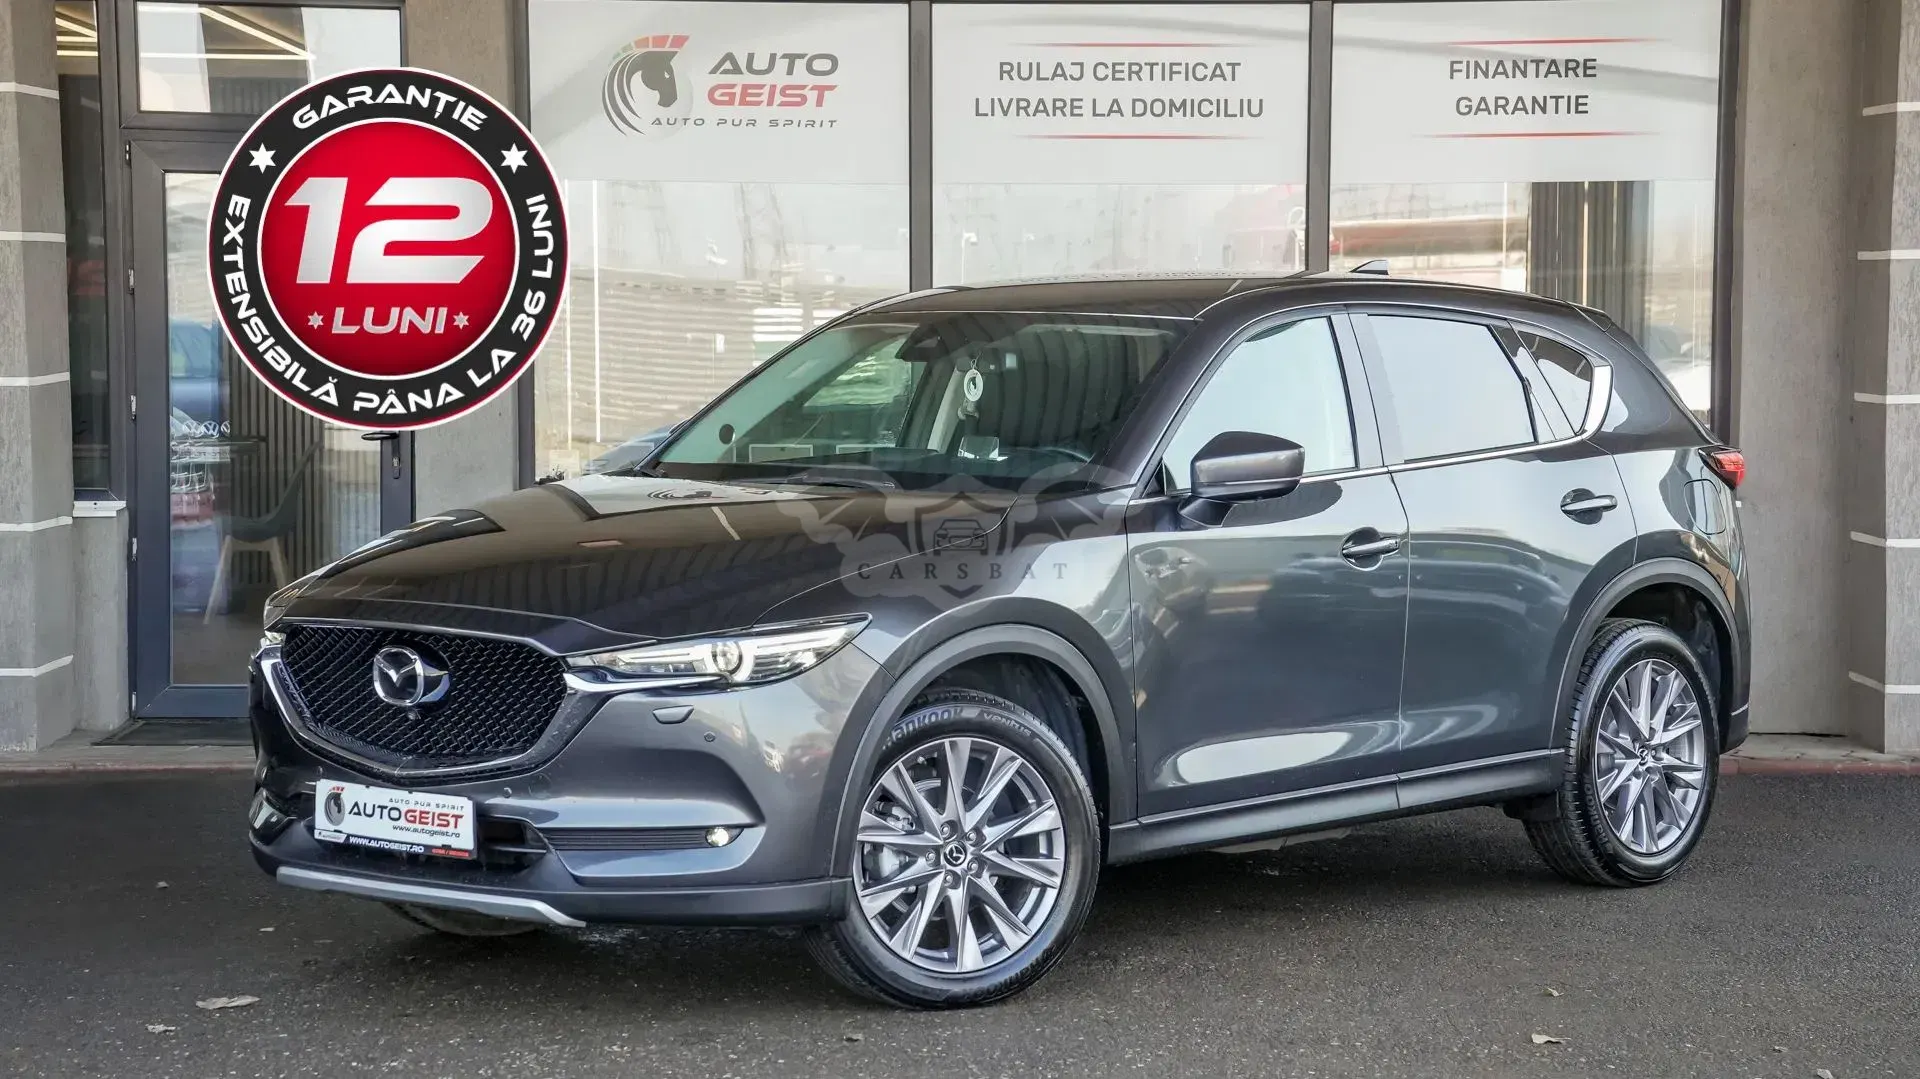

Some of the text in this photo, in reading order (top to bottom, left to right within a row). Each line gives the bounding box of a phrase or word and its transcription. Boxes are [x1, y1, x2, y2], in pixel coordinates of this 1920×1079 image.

[708, 51, 839, 77] AUTO
[999, 61, 1241, 82] RULAJ CERTIFICAT
[1449, 58, 1597, 80] FINANTARE
[707, 83, 838, 107] GEIST
[1455, 94, 1589, 116] GARANTIE
[975, 97, 1264, 118] LIVRARE LA DOMICILIU
[651, 117, 838, 128] AUTO PUR SPIRIT
[389, 797, 465, 812] AUTO PUR SPIRIT
[349, 836, 425, 853] WWW.AUTOGEIST.RO
